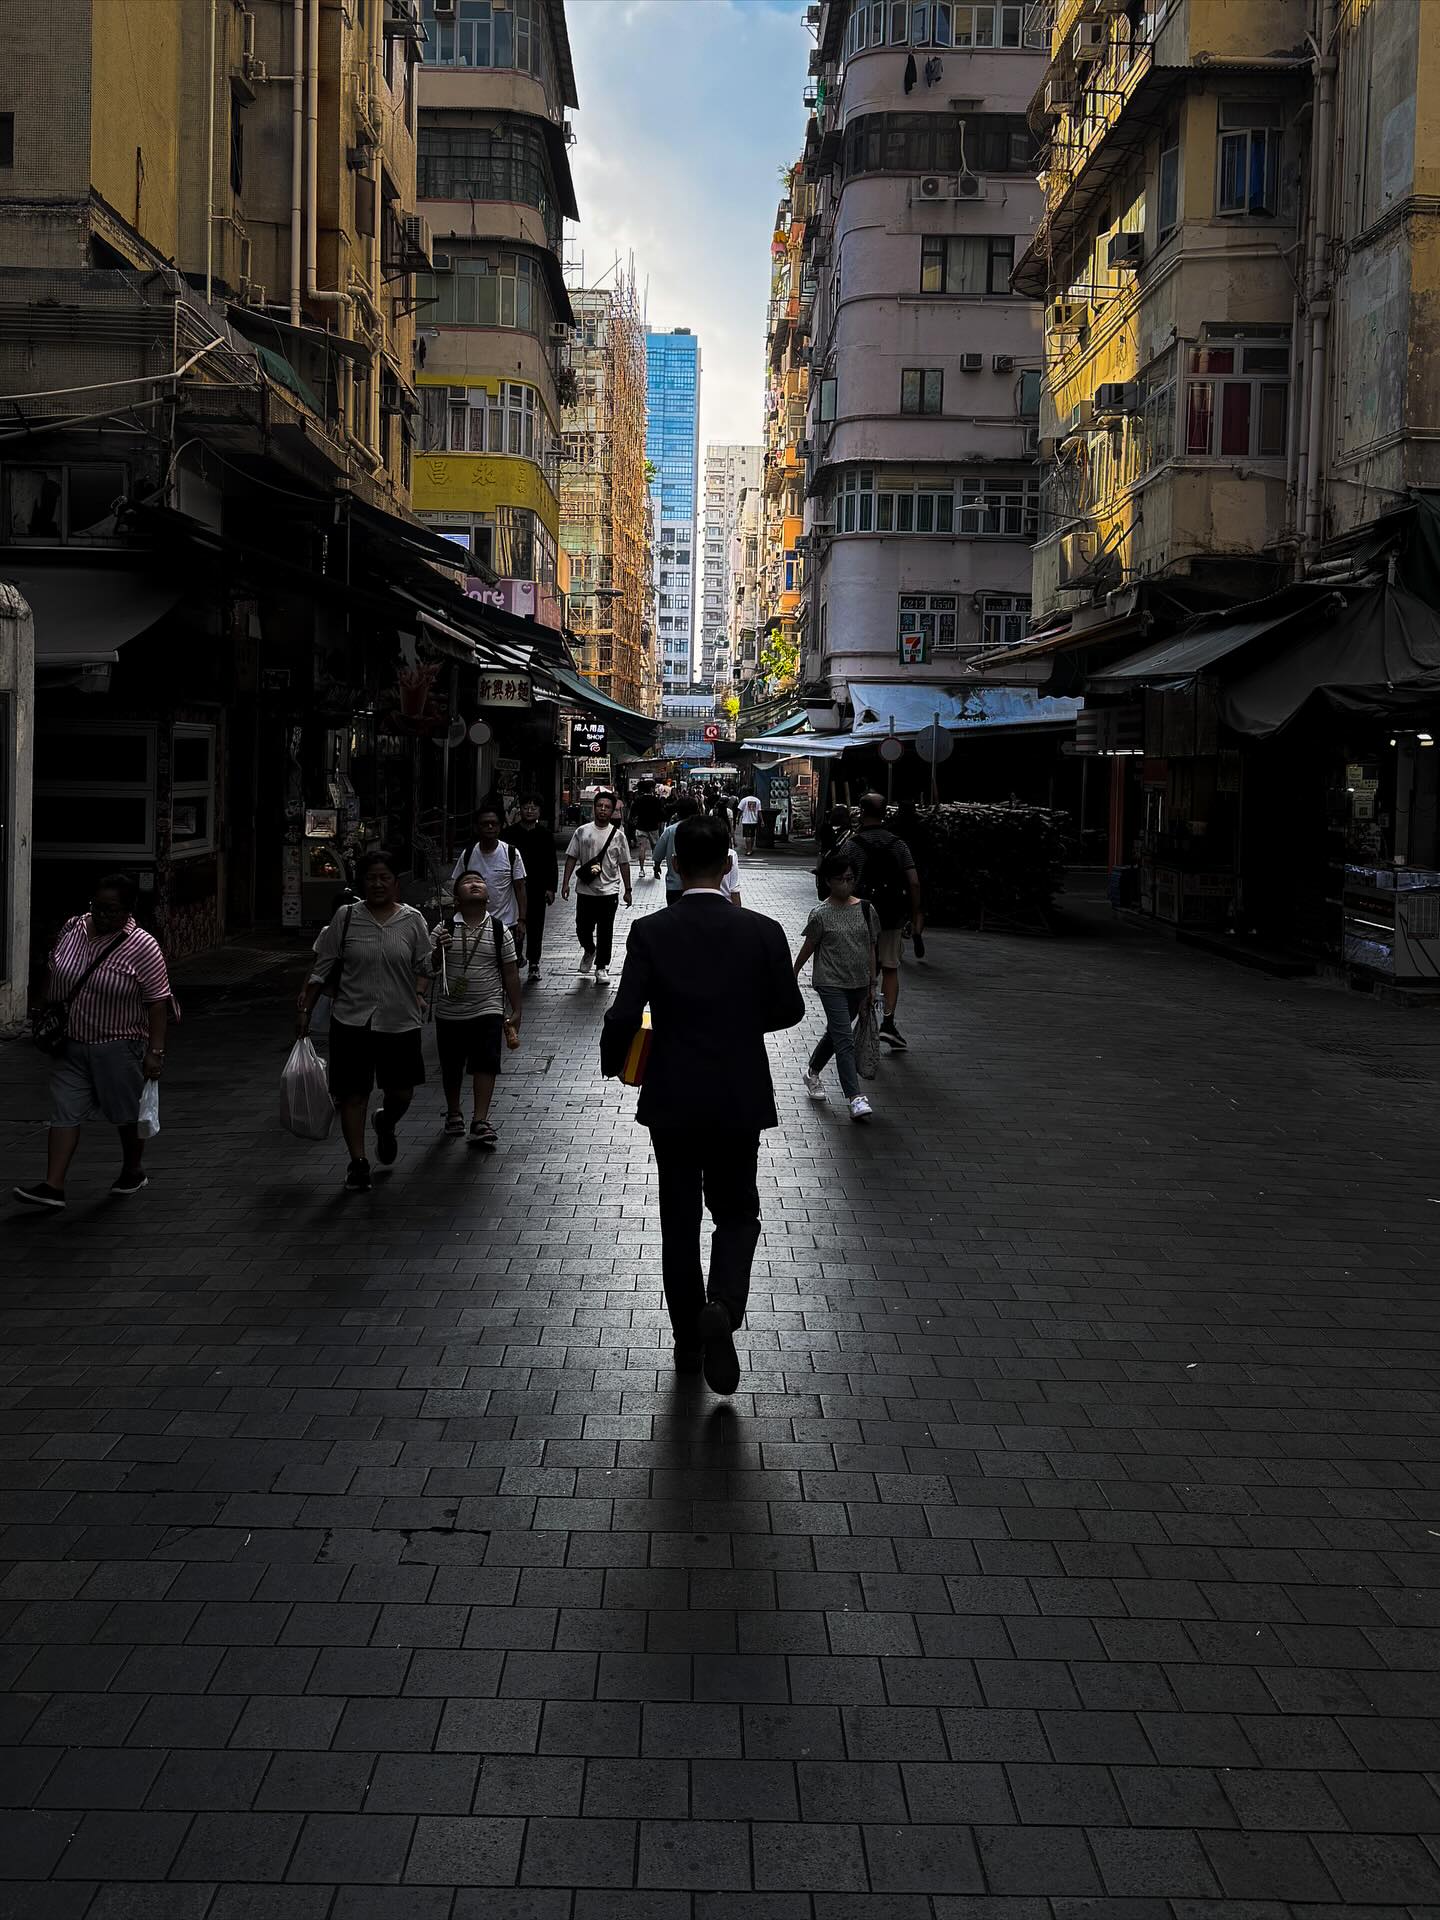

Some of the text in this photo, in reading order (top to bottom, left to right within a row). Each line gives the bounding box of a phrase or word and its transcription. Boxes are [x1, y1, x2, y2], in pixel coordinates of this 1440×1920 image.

[480, 678, 529, 702] 新興粉麵
[574, 723, 605, 733] 成人用品
[586, 733, 604, 741] SHOP
